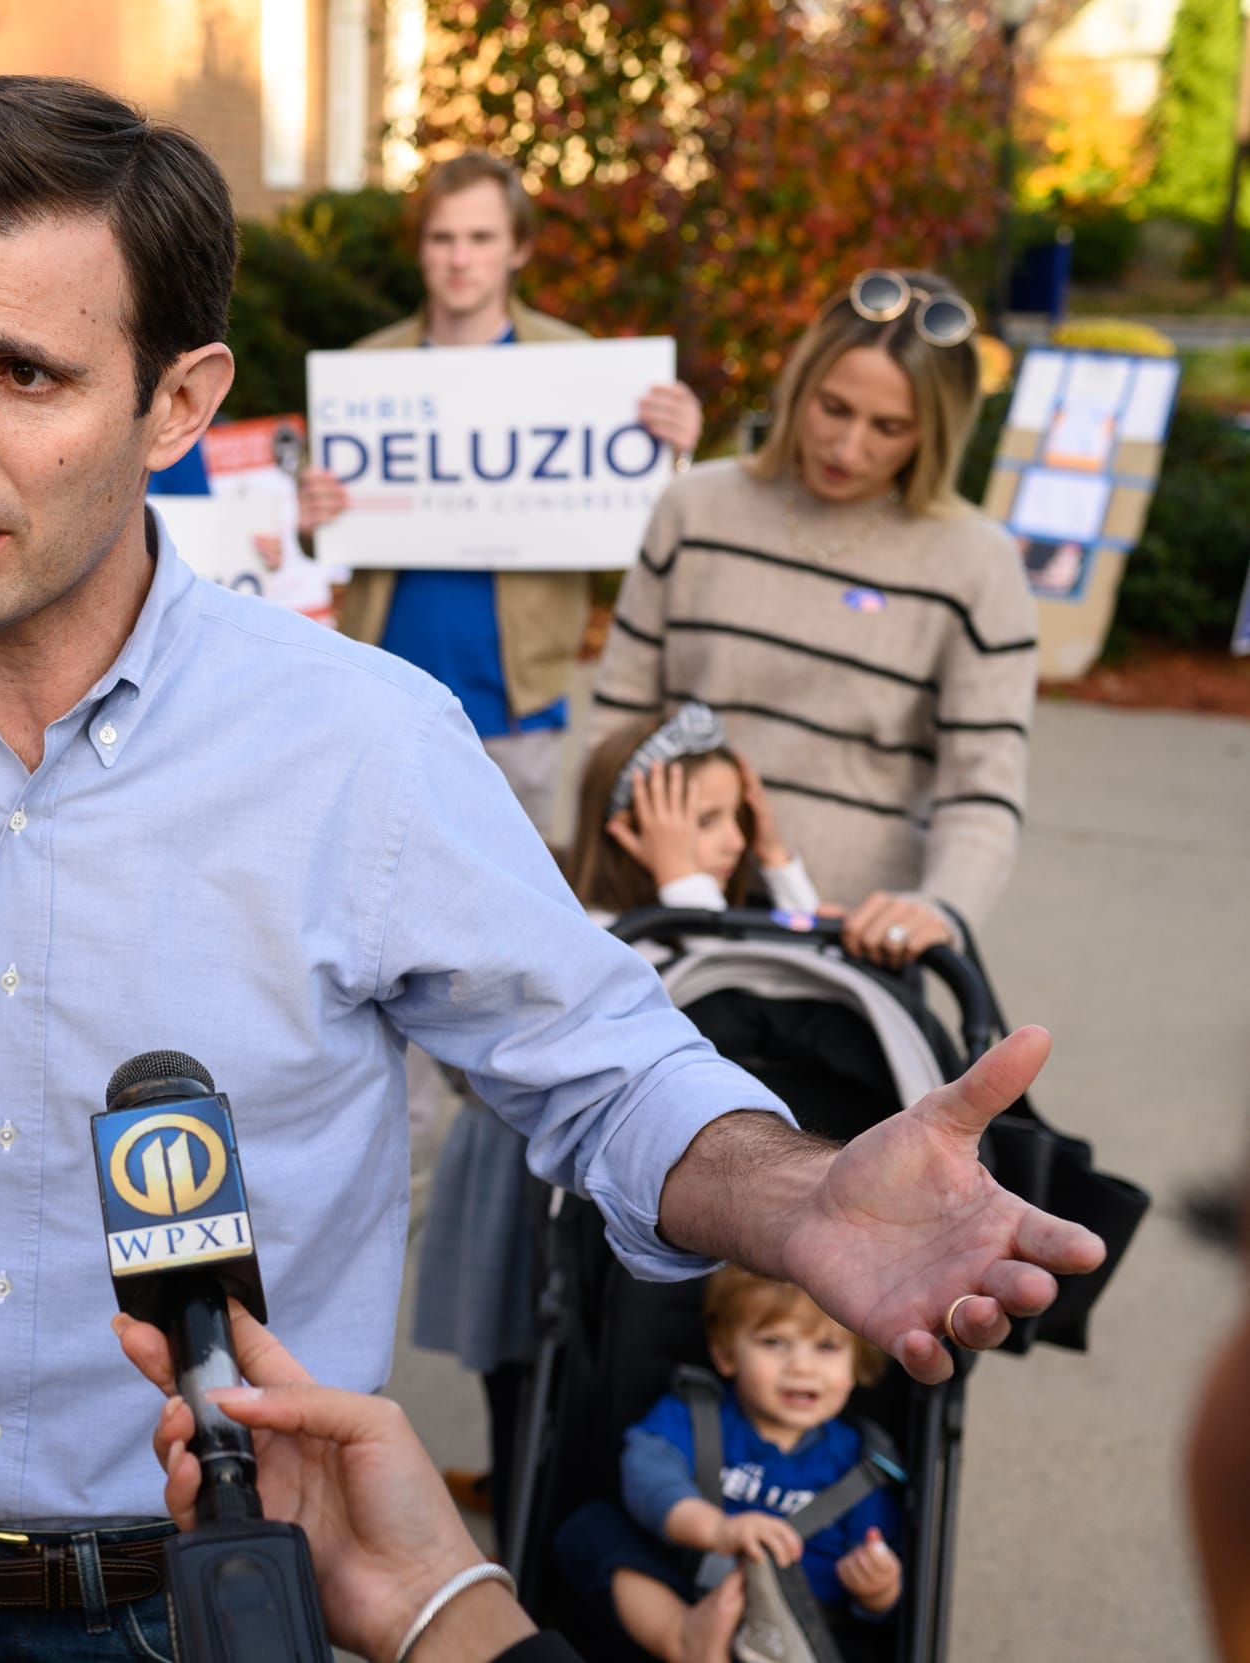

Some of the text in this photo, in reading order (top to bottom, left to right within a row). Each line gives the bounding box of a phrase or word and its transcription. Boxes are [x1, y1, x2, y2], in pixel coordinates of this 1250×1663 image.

[316, 396, 439, 424] CHRIS
[322, 426, 661, 484] DELUZIO
[113, 1216, 247, 1263] WPXI
